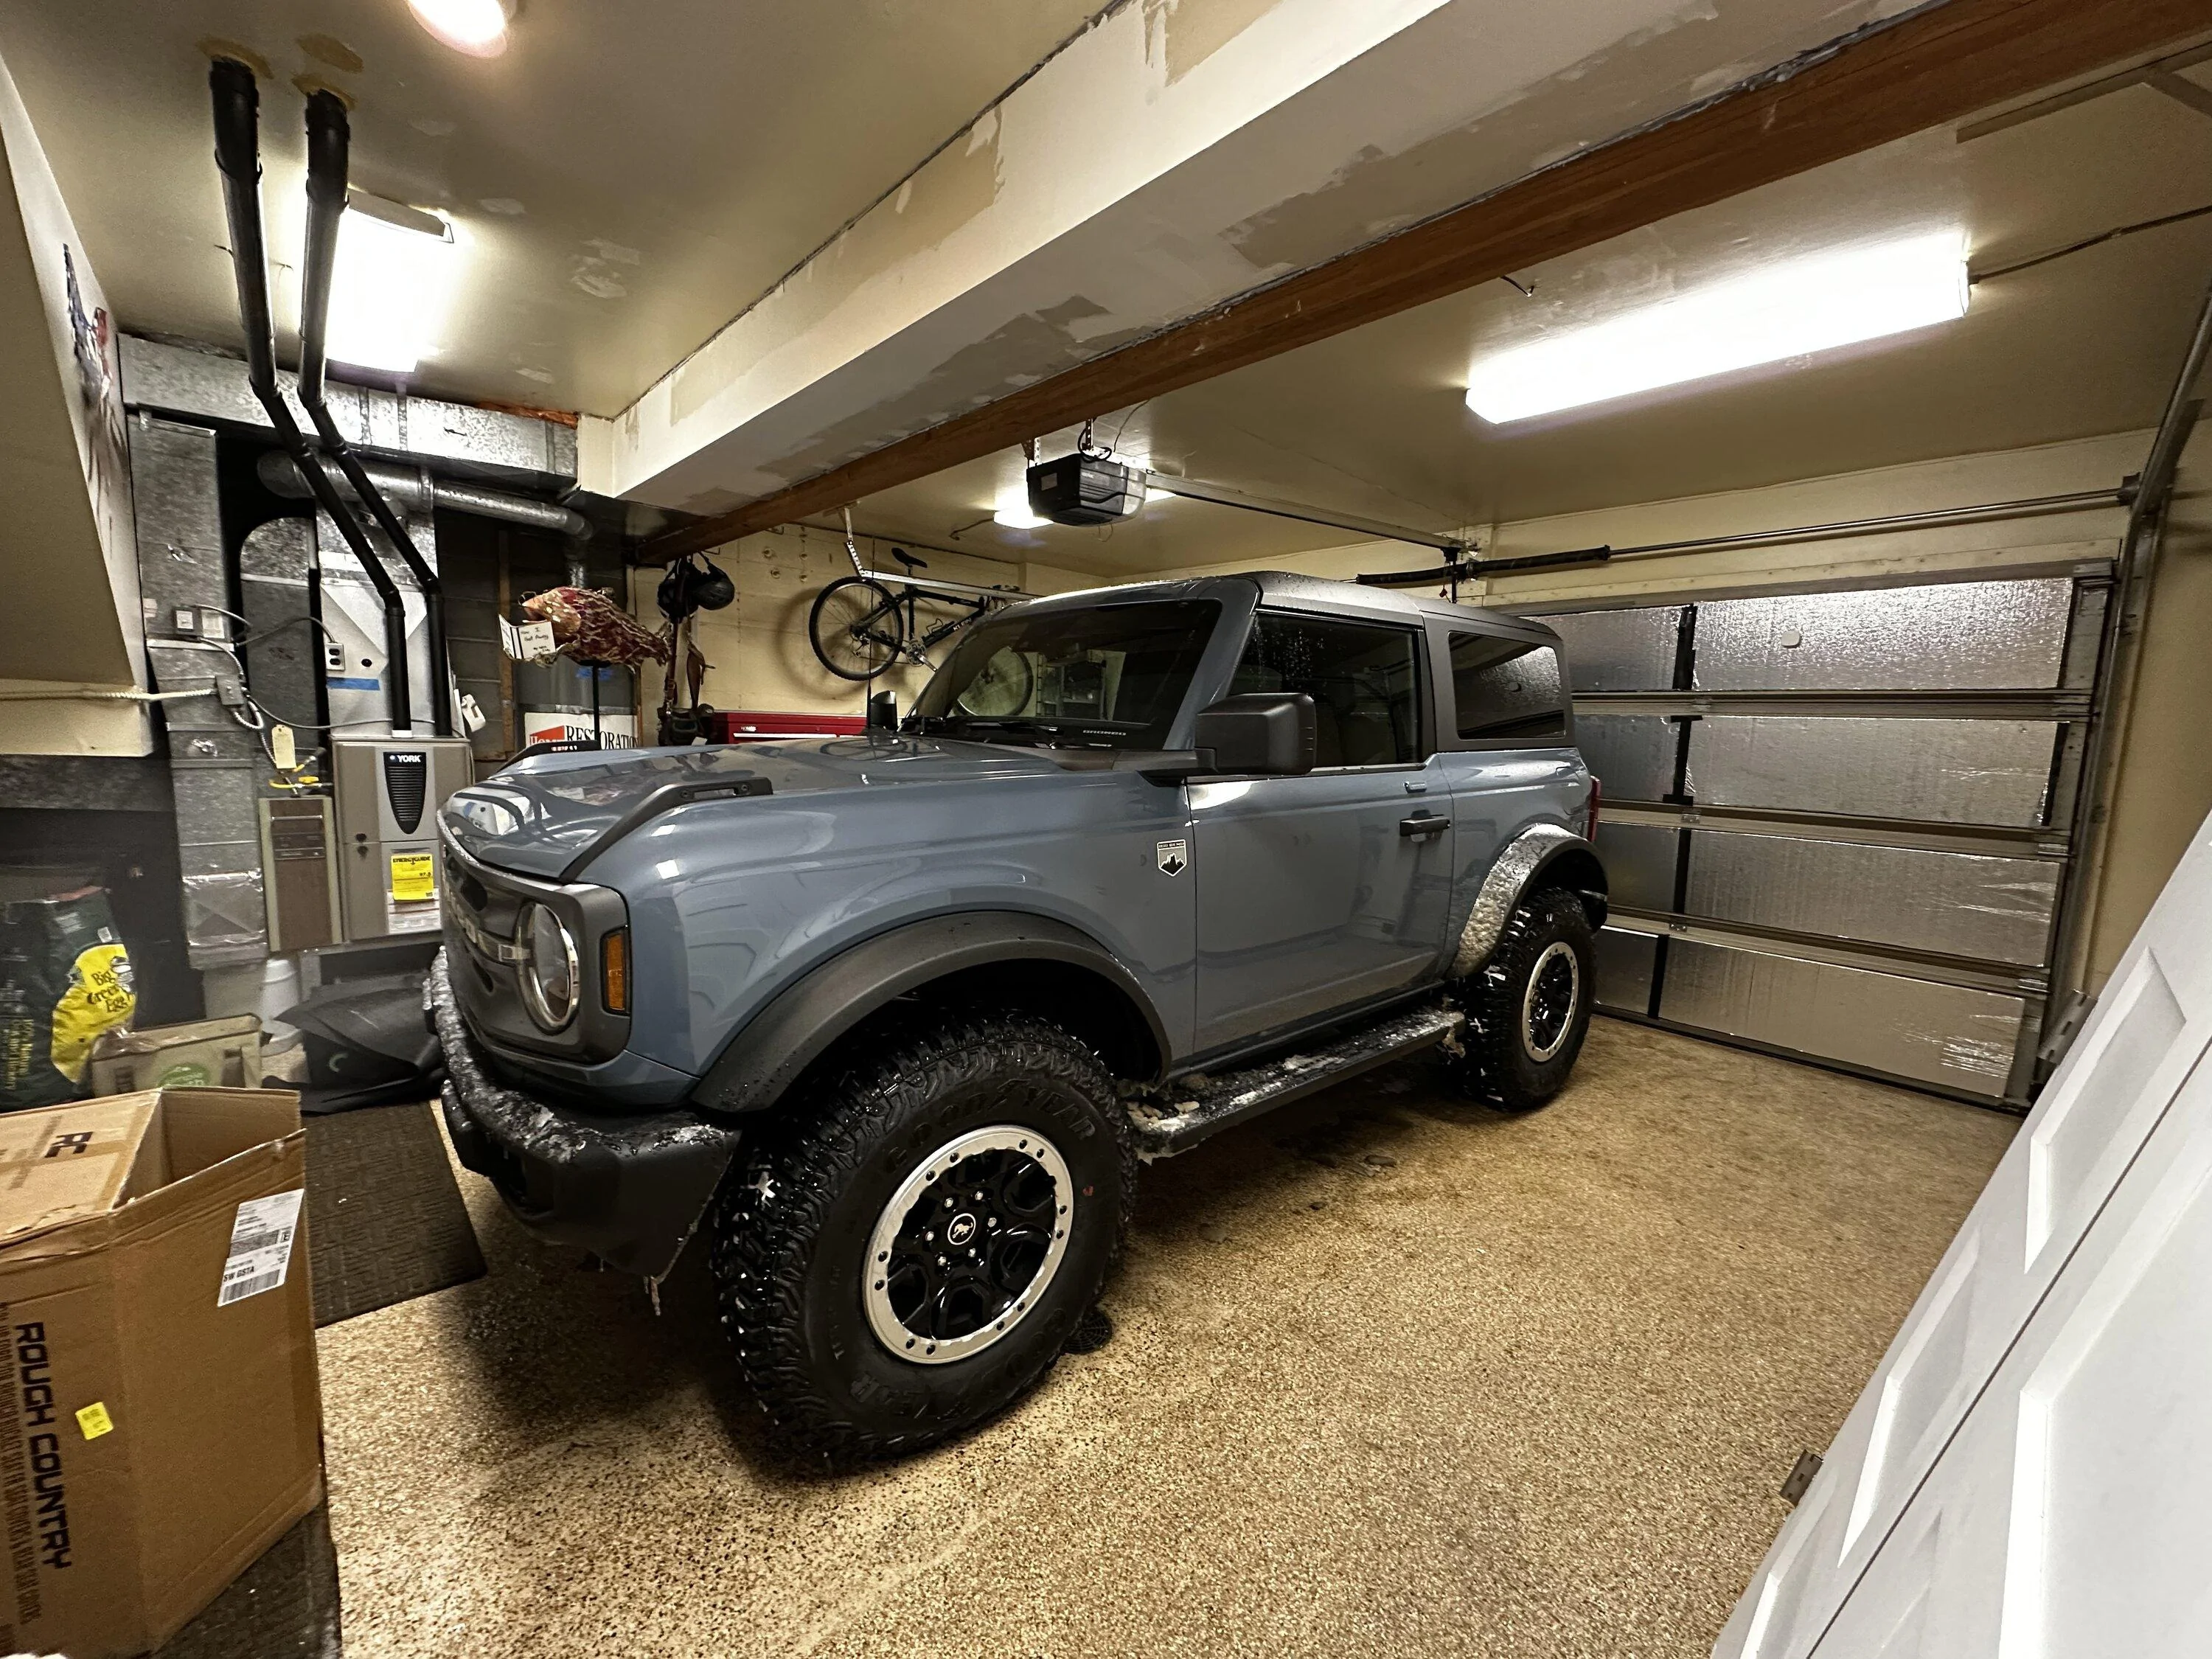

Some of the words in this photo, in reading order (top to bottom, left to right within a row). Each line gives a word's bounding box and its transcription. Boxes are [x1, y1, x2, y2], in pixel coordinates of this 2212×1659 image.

[566, 726, 639, 751] RESORATION
[396, 754, 422, 763] YORK
[91, 970, 116, 987] Big
[15, 1322, 55, 1427] ROUGH
[28, 1432, 72, 1571] COUNTRY
